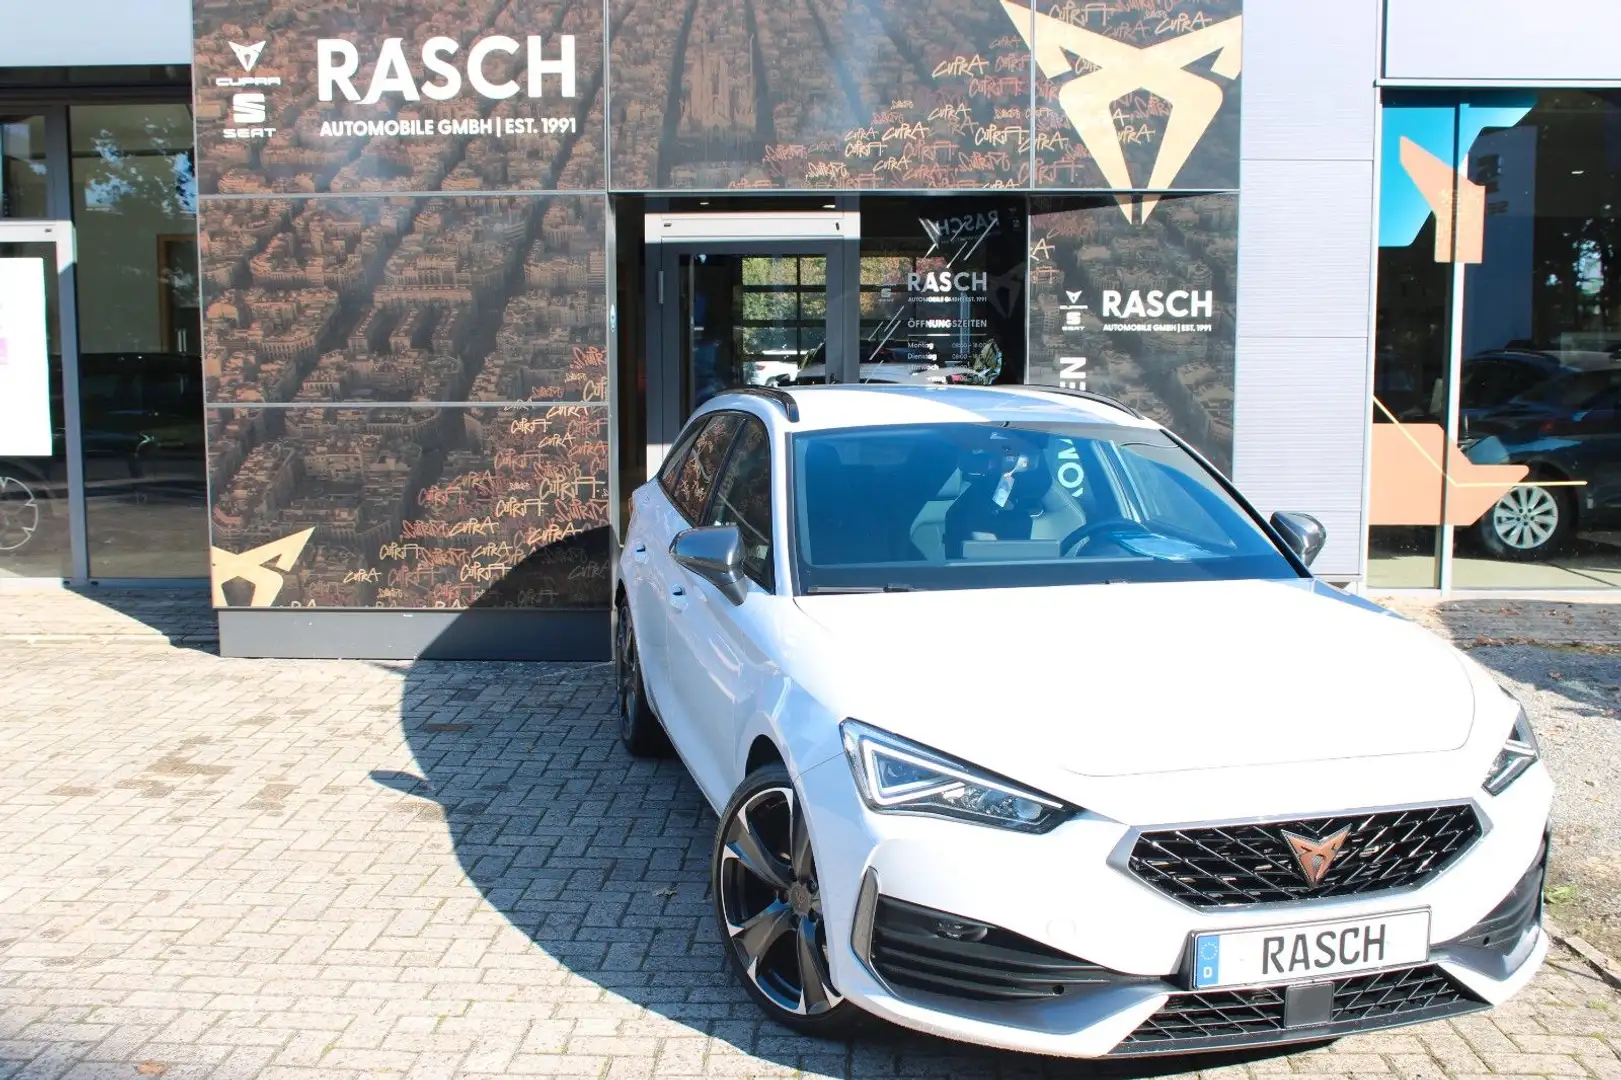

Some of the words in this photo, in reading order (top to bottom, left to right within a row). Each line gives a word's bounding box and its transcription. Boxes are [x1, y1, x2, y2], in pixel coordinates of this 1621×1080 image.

[1154, 11, 1212, 35] CUPRA
[317, 35, 576, 104] RASCH
[932, 54, 989, 80] CUPRA
[216, 77, 281, 87] CUPRA
[928, 103, 971, 122] CUPRA
[223, 128, 276, 138] SEAT
[320, 120, 434, 137] AUTOMOBILE
[437, 118, 492, 135] GMBH
[505, 117, 537, 134] EST.
[541, 117, 576, 134] 1991
[881, 121, 930, 142] CUPRA
[872, 155, 912, 172] CUPRA
[908, 272, 987, 293] RASCH
[1102, 290, 1213, 319] RASCH
[907, 318, 987, 328] ÖFFNUNGSZEITEN
[1103, 324, 1152, 332] AUTOMOBILE
[1196, 324, 1211, 332] 1991
[538, 433, 576, 448] CUPRA
[449, 516, 499, 537] CUPRA
[472, 541, 513, 557] CUPRA
[344, 567, 382, 583] CUPRA
[1262, 924, 1385, 974] RASCH
[1203, 967, 1213, 978] D
